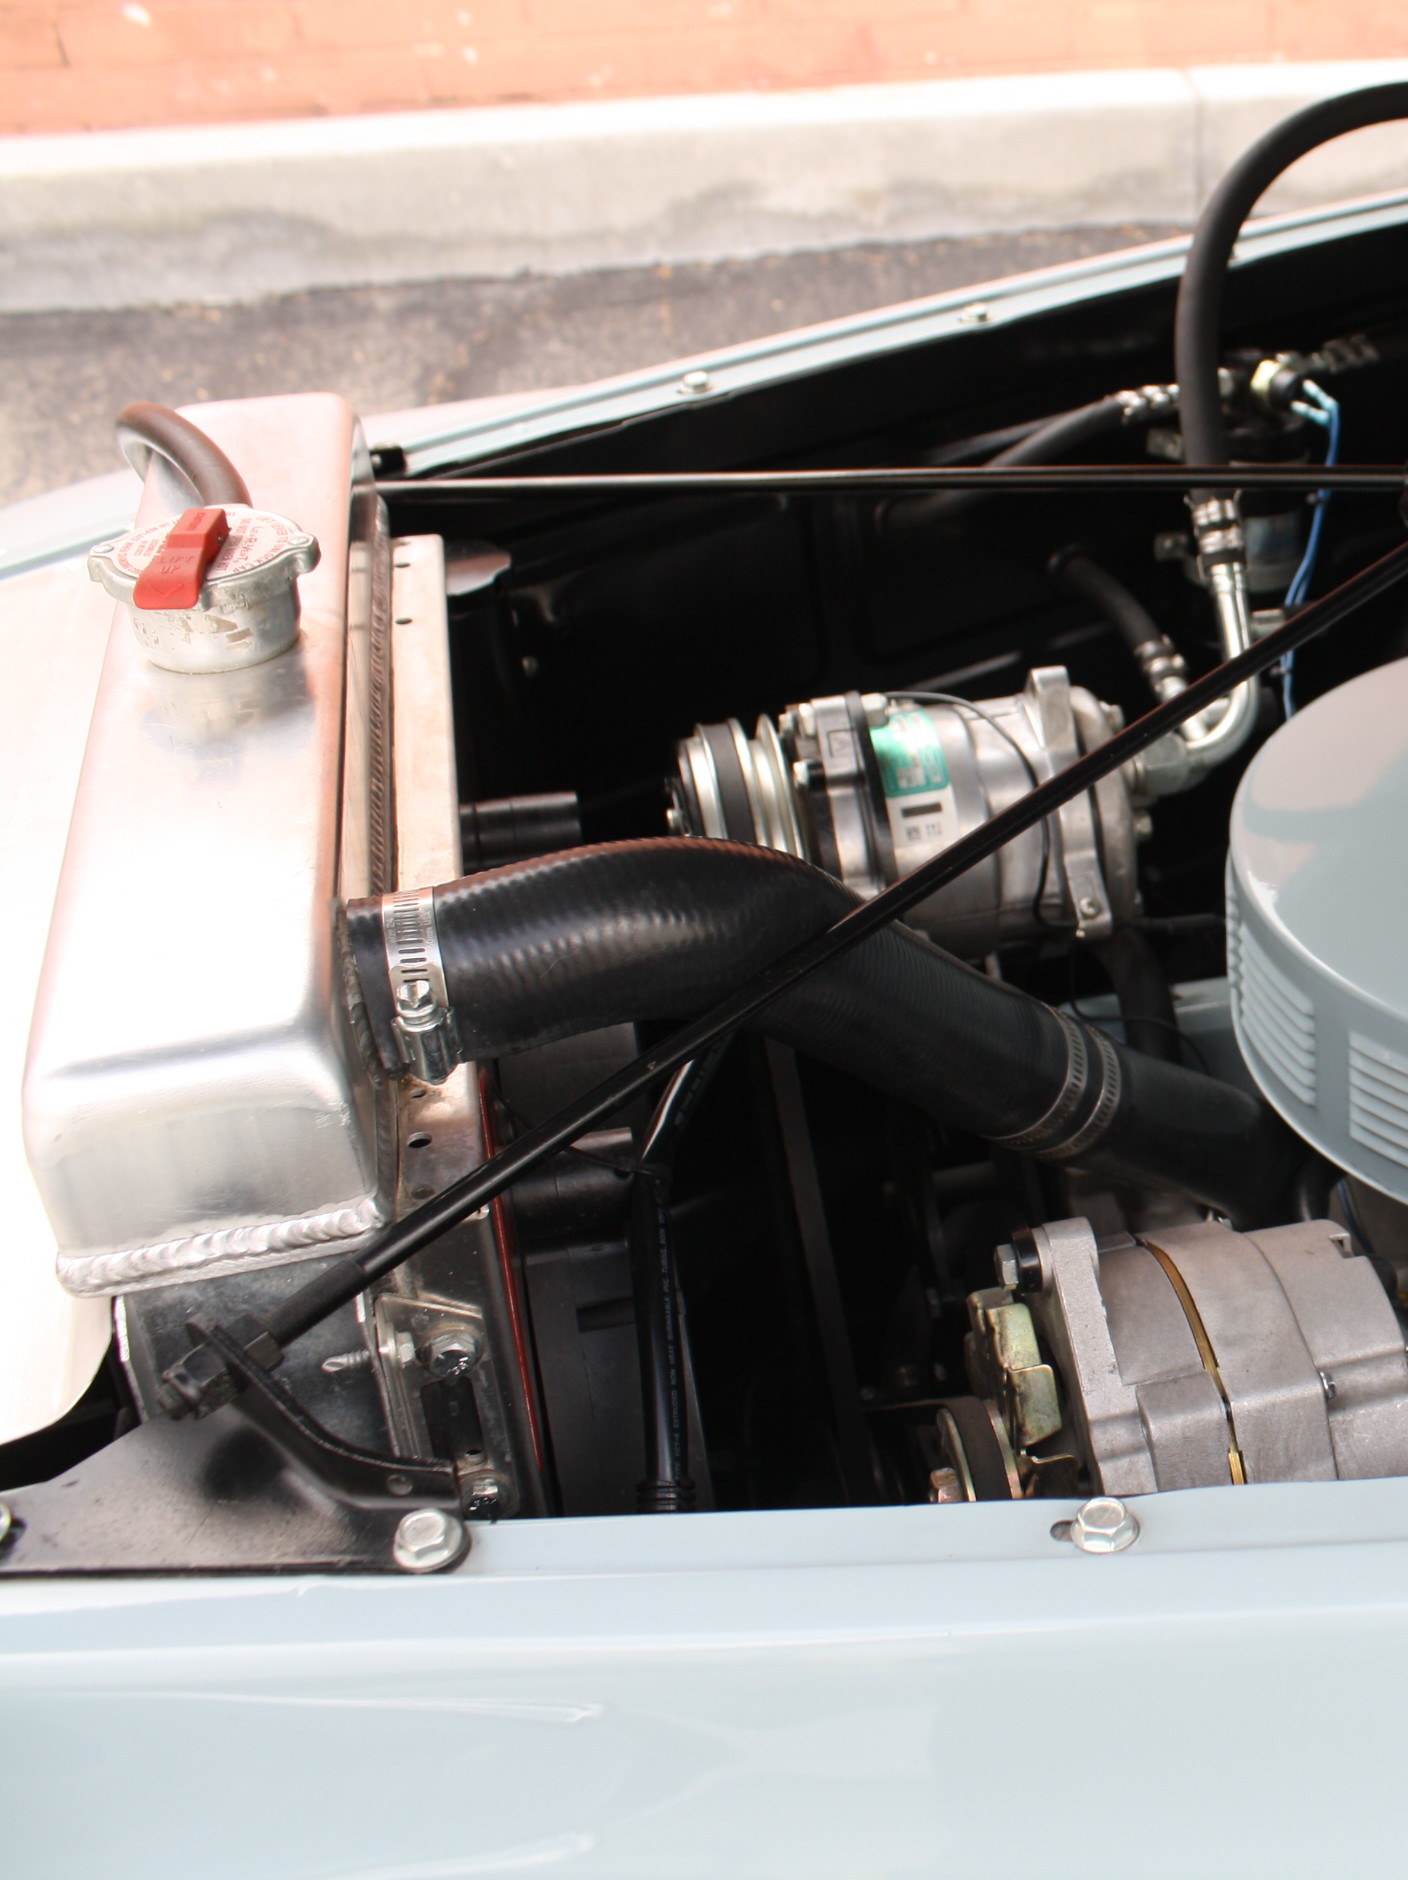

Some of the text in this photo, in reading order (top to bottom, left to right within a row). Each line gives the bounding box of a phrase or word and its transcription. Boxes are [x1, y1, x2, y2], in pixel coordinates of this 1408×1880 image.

[160, 555, 195, 564] LIFT
[161, 565, 181, 574] UP
[671, 1390, 680, 1428] EXTRUDED
